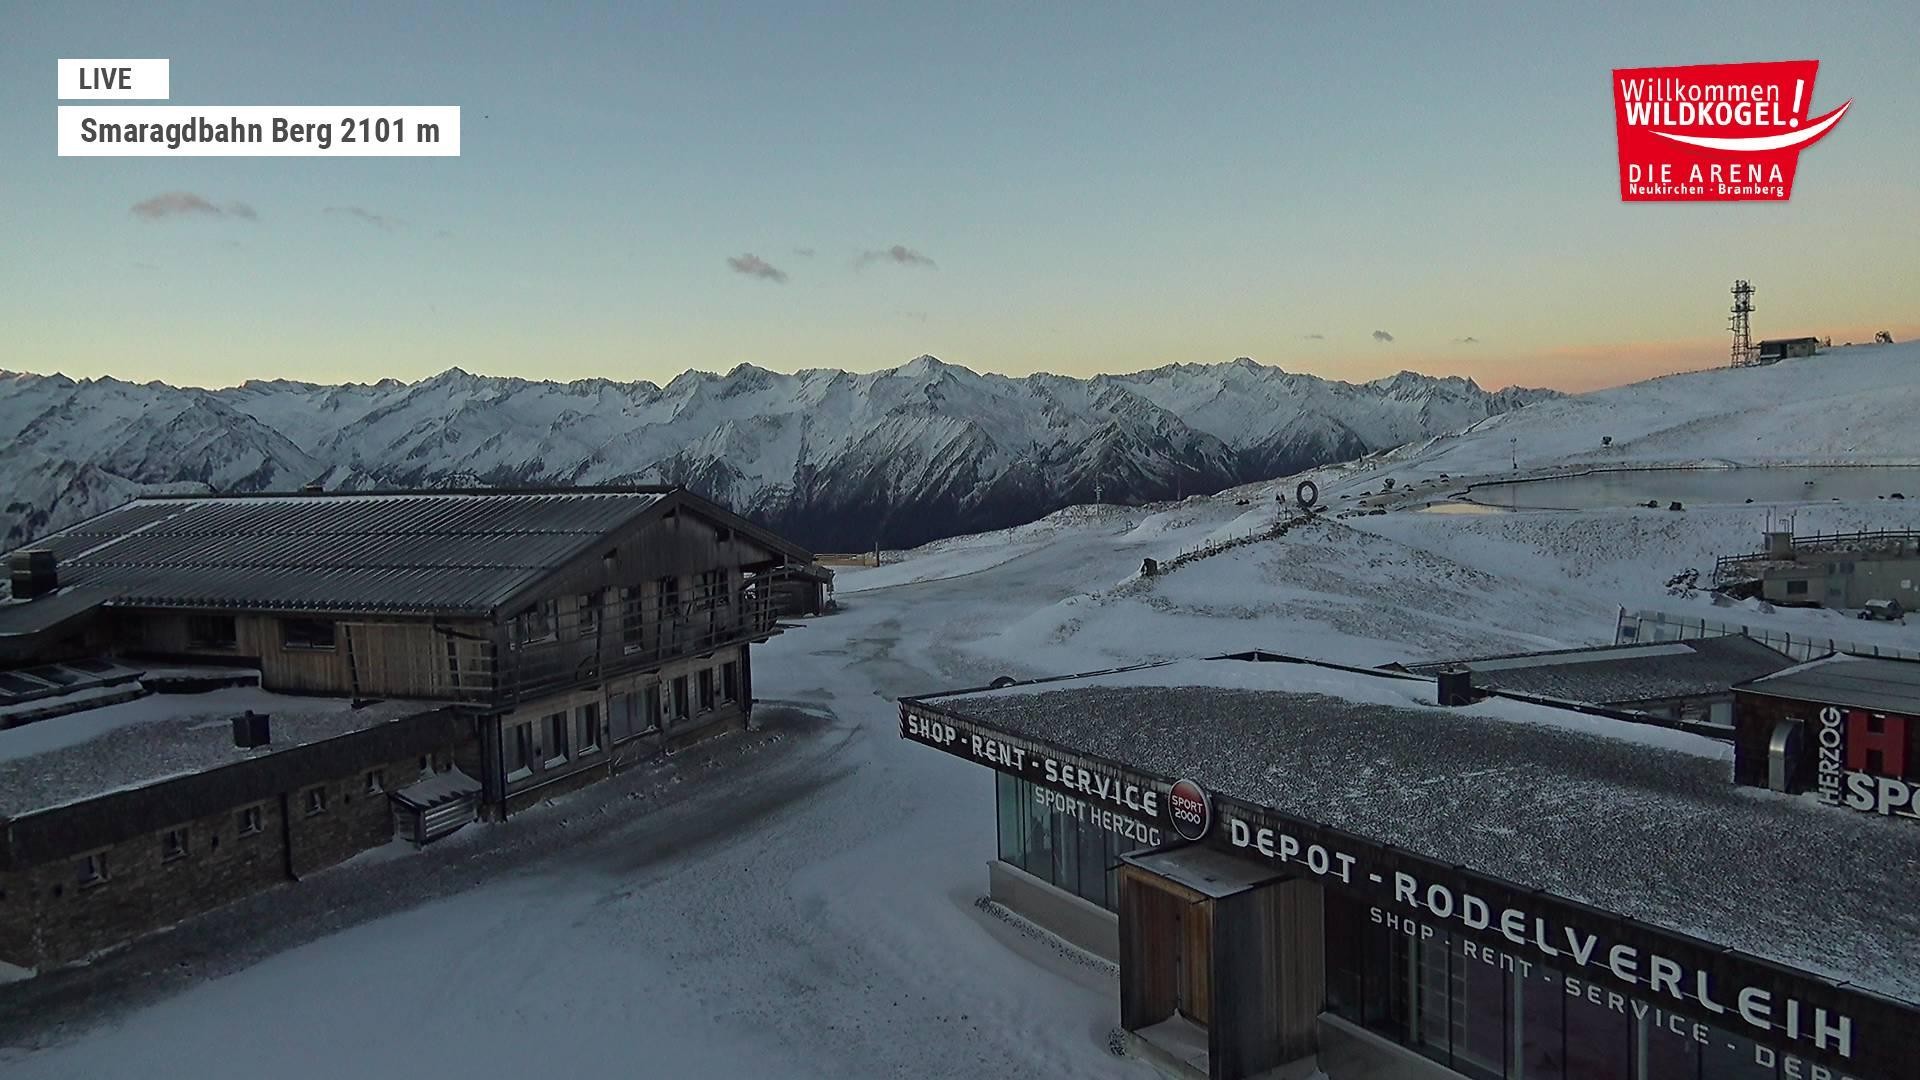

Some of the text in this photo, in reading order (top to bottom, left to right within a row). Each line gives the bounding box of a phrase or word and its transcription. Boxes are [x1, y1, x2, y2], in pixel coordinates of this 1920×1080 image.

[908, 714, 957, 746] SHOP
[972, 734, 1025, 771] RENT
[1045, 758, 1158, 817] SERVICE
[1172, 794, 1203, 813] SPORT
[1819, 706, 1841, 805] HERZOG
[1035, 786, 1161, 847] SPORT HERZOG
[1174, 807, 1201, 825] 2000
[1231, 818, 1357, 884] DEPOT
[1394, 870, 1852, 1058] RODELVERLEIH
[1370, 907, 1434, 941] SHOP
[1463, 939, 1533, 979] RENT
[1565, 977, 1710, 1046] SERVICE
[1755, 1044, 1856, 1080] DEP
